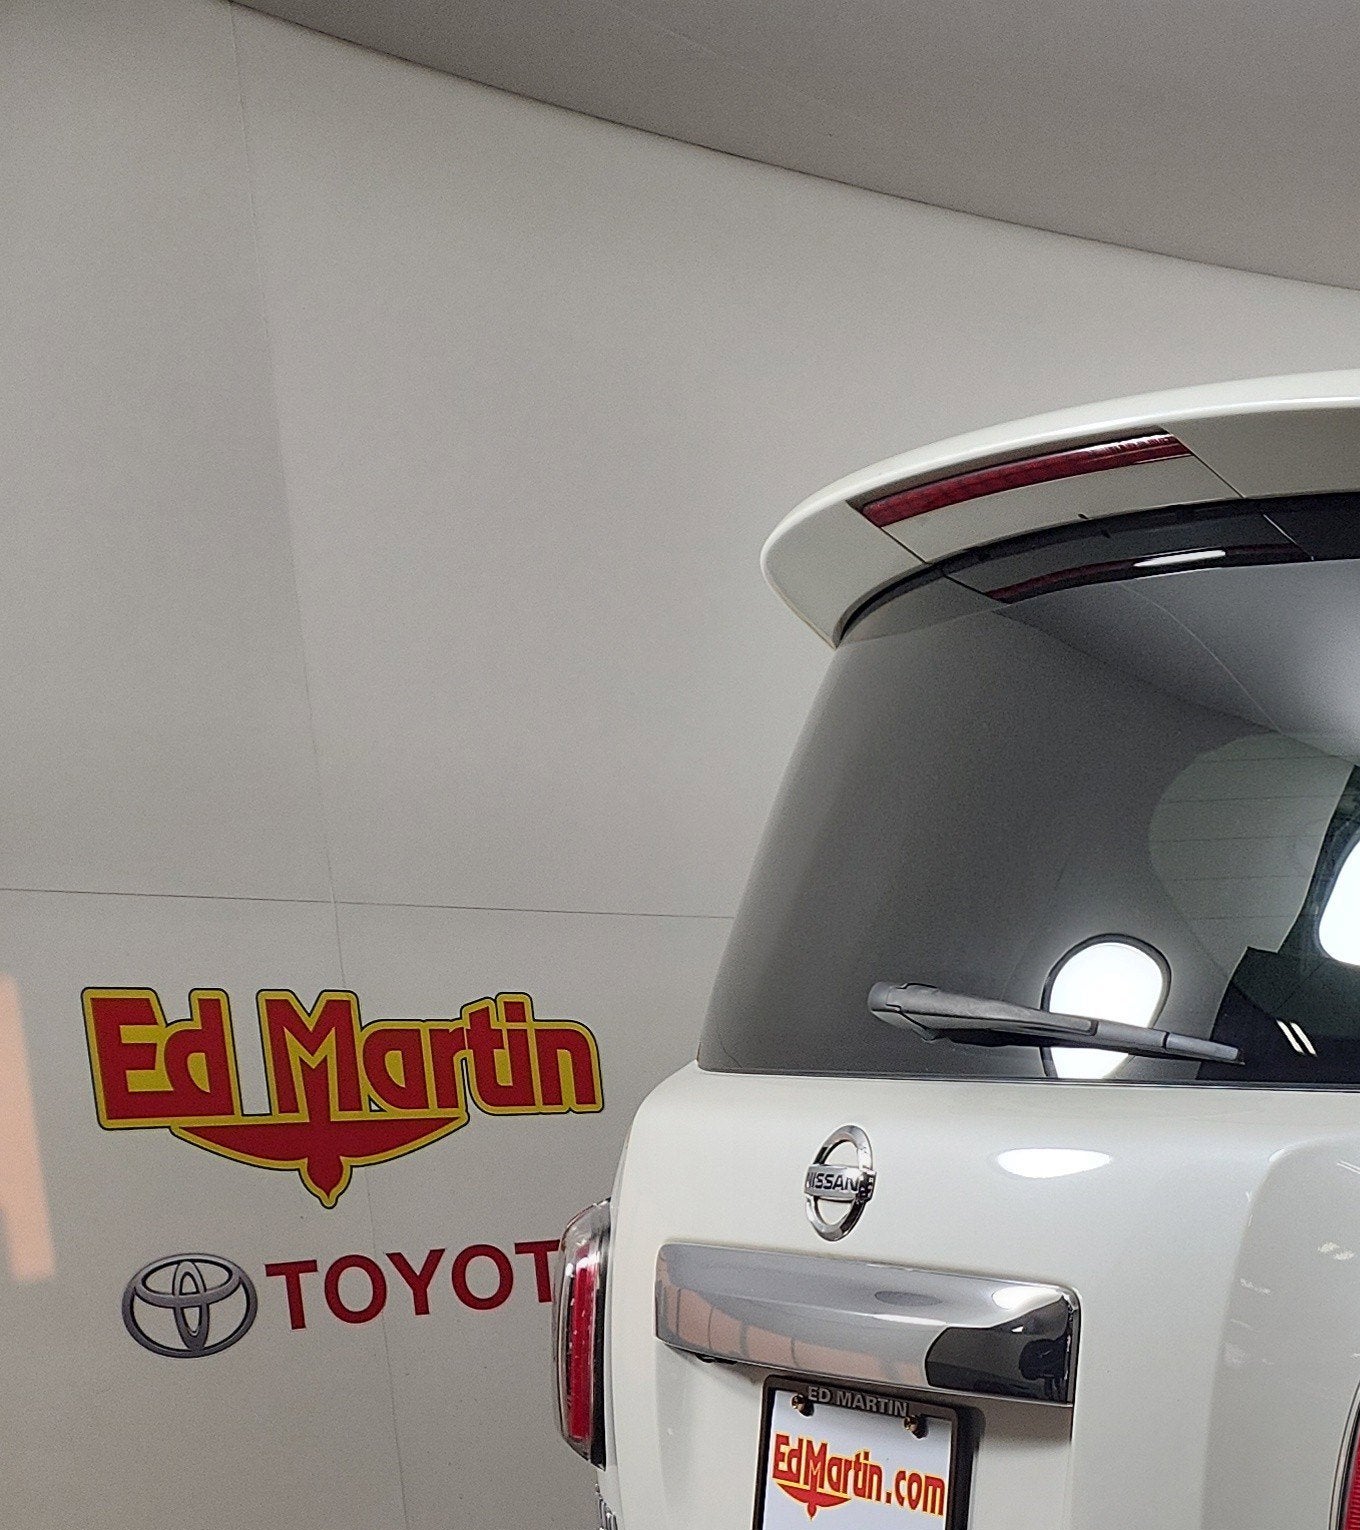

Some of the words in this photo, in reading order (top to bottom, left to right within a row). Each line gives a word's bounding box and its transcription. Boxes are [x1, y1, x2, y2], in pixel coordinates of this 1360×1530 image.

[89, 995, 236, 1121] Ed
[263, 997, 598, 1114] Martin
[806, 1171, 859, 1192] NISSAN
[266, 1239, 560, 1330] TOYOT
[808, 1386, 831, 1402] ED
[836, 1390, 907, 1417] MARTIN
[771, 1432, 946, 1516] EdMartin.com
